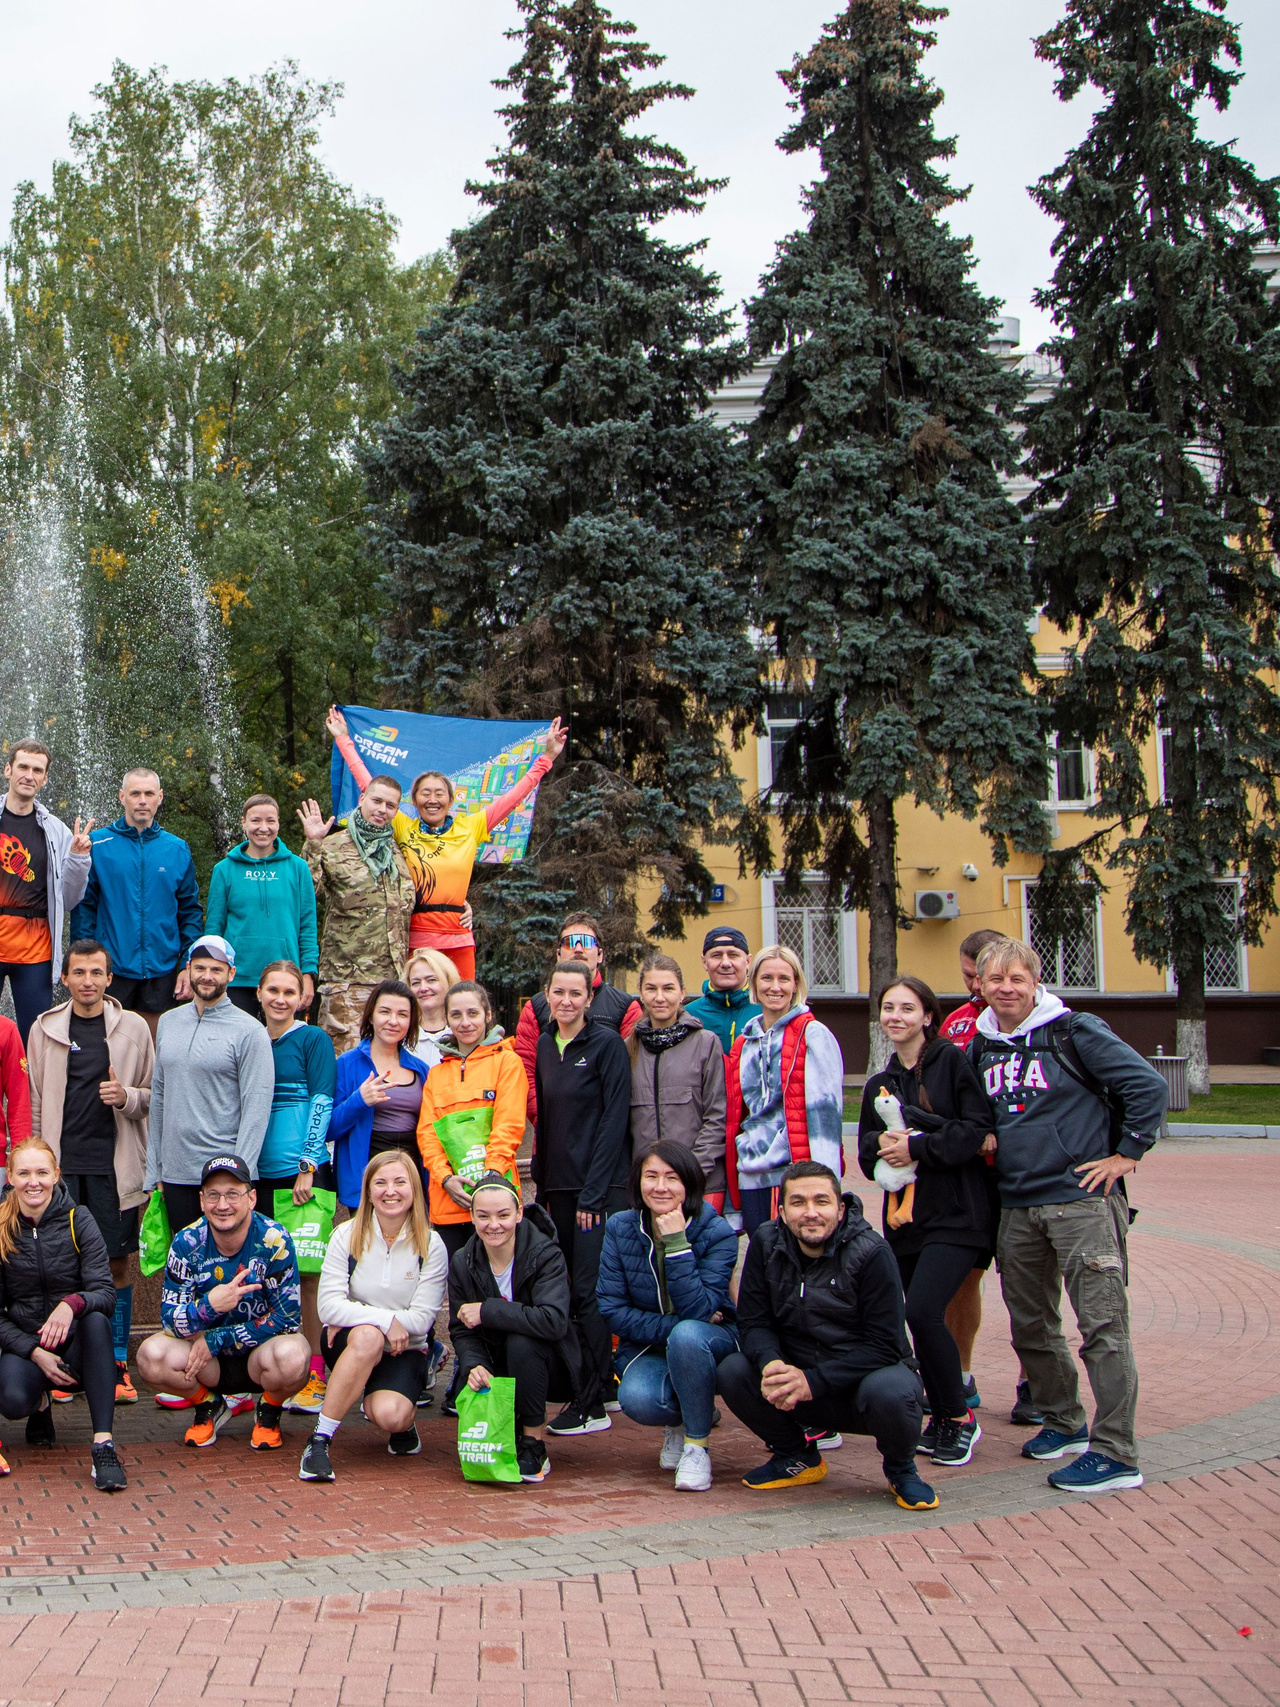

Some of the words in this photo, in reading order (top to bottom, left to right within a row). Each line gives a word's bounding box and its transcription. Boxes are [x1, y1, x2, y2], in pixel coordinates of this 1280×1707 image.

[354, 733, 409, 759] DREAM
[359, 744, 399, 767] TRAIL
[245, 870, 277, 878] ROXY
[983, 1059, 1050, 1097] USA
[994, 1090, 1038, 1102] JEANS
[303, 1103, 325, 1154] EXPLORE
[457, 1161, 486, 1177] DRE
[293, 1239, 328, 1251] REAM
[295, 1247, 325, 1259] RAIL
[459, 1451, 497, 1463] TRAIL
